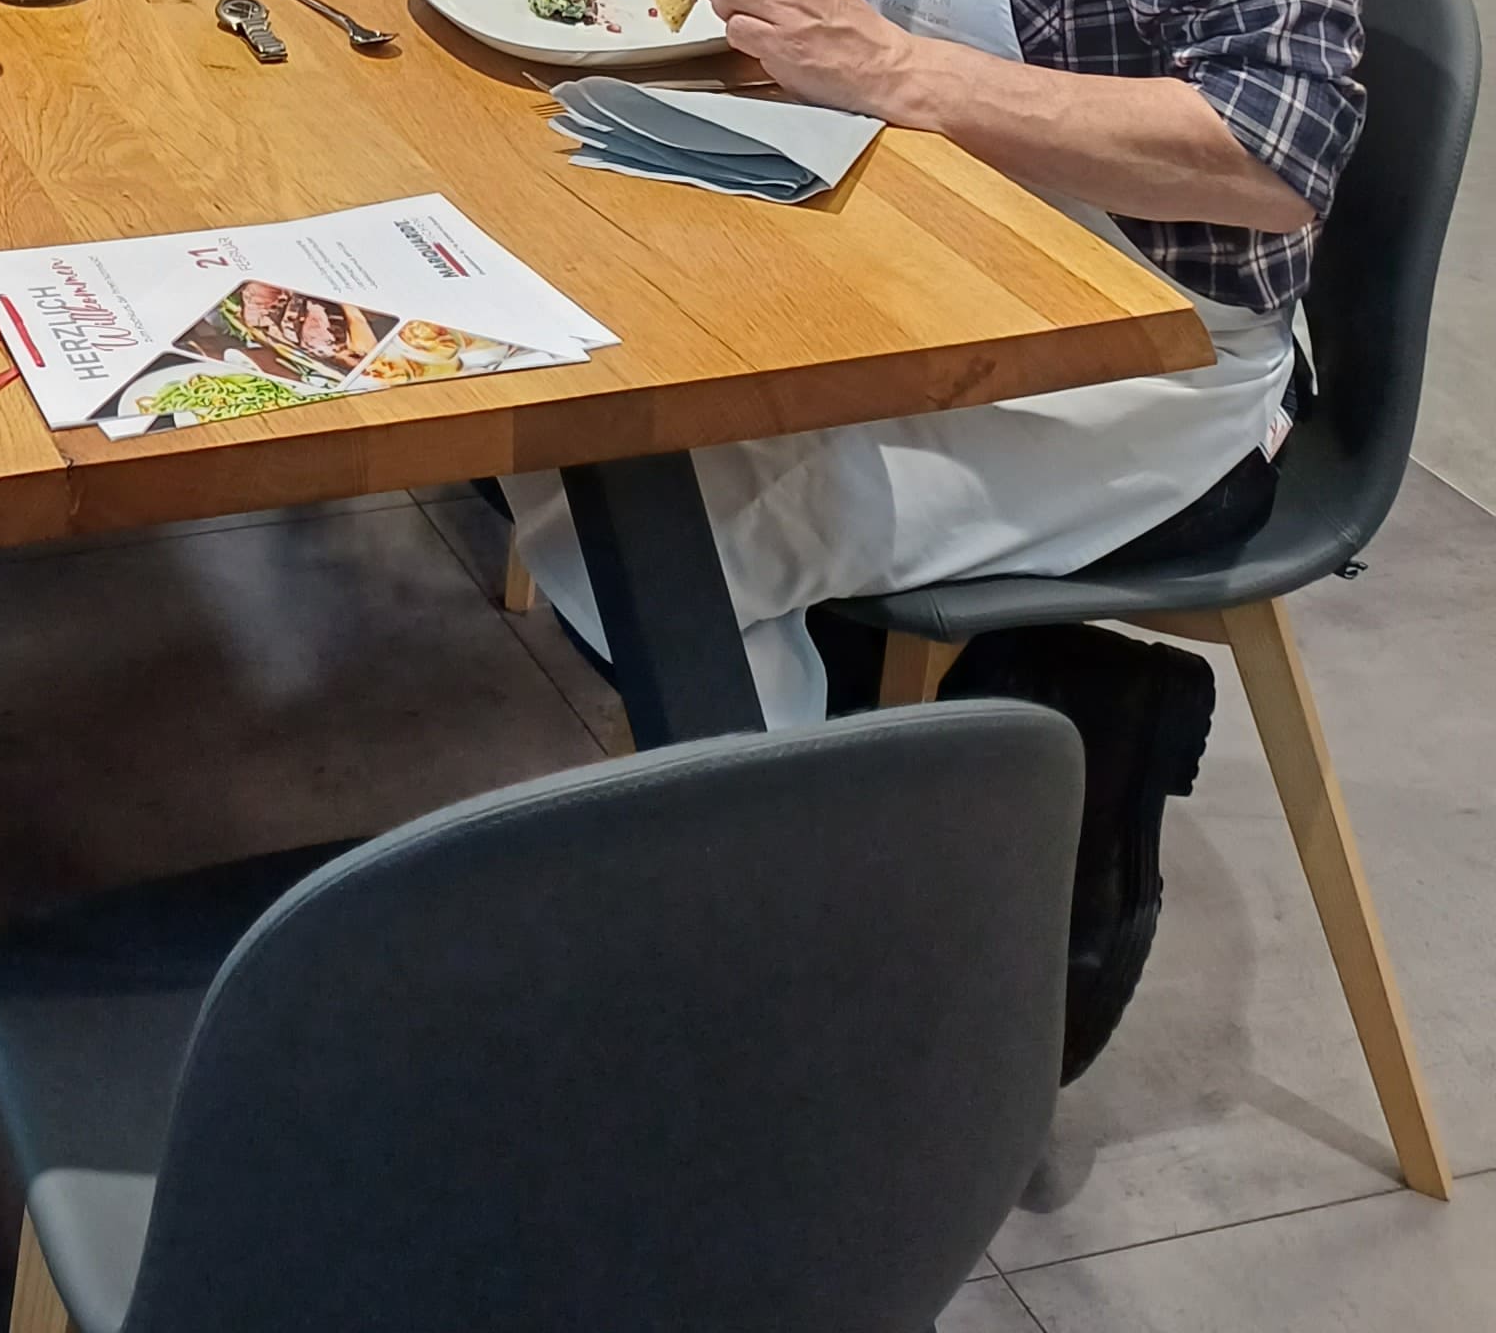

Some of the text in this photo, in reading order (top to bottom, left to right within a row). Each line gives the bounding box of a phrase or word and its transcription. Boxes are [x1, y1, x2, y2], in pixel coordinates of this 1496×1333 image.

[187, 247, 229, 269] 21
[393, 220, 460, 278] MARQUARDT
[34, 286, 110, 380] HERZLICH
[50, 257, 139, 351] Willkommen
